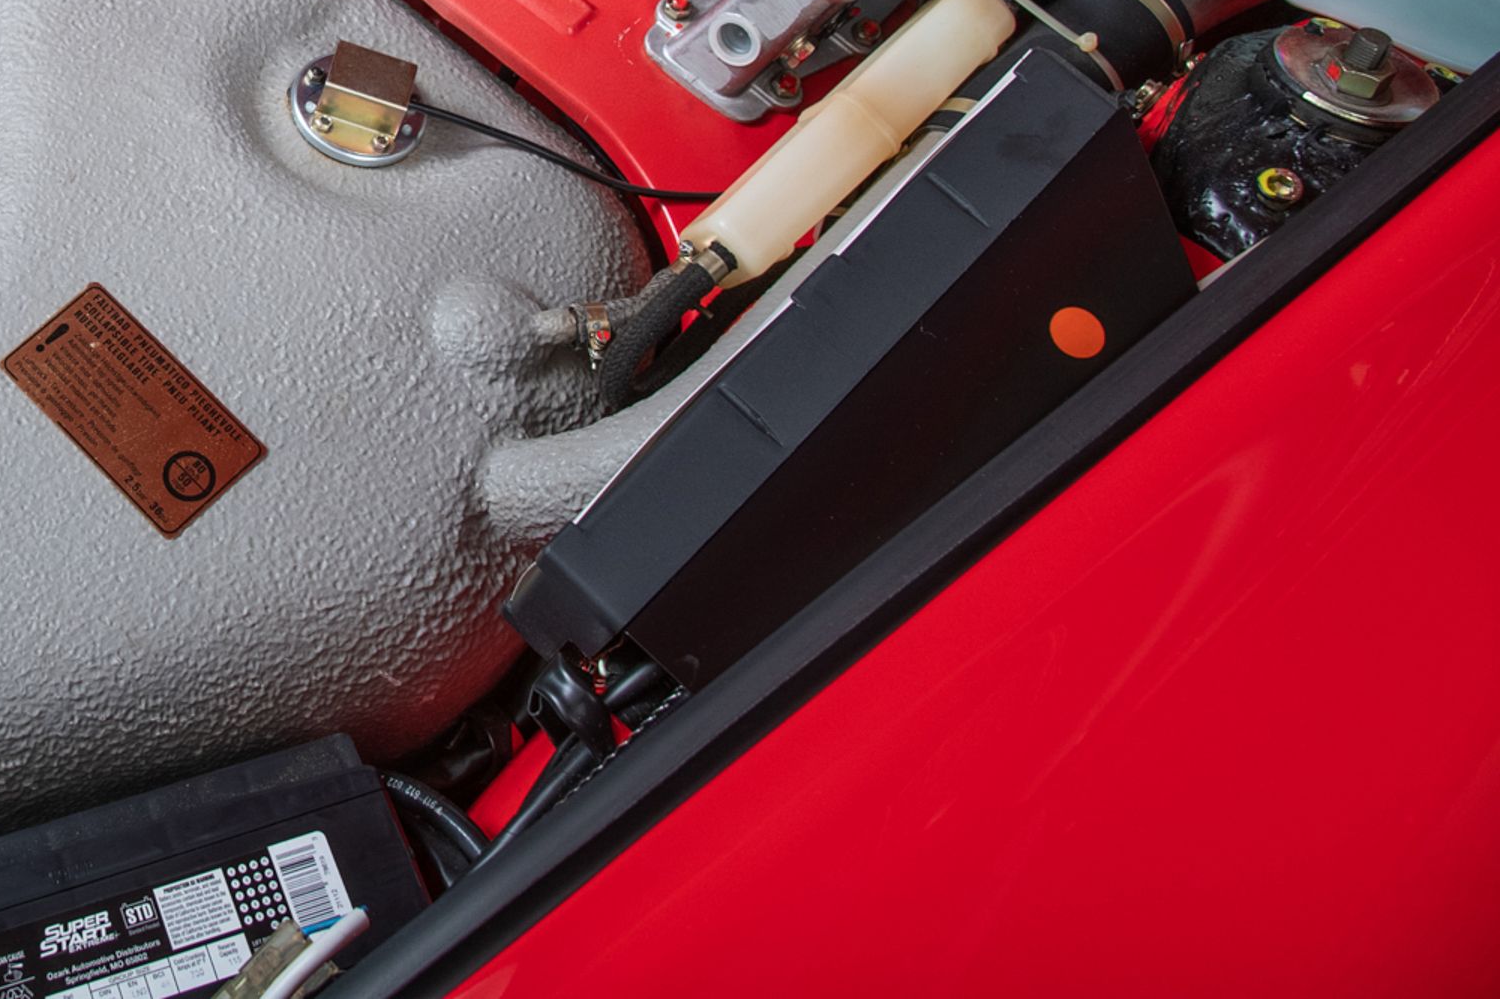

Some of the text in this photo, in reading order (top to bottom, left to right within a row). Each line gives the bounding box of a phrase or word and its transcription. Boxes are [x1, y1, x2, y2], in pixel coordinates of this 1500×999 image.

[82, 301, 138, 355] COLLAPSIBLE
[137, 355, 160, 376] TIRE
[161, 379, 188, 405] PNEU
[186, 404, 221, 437] PLIANT
[133, 333, 191, 390] PNEUMATICO
[188, 389, 243, 442] PIEGHEVOLE
[43, 910, 110, 940] SUPER
[124, 902, 154, 924] STD
[37, 921, 114, 956] START
[45, 938, 161, 980] Ozark Automotive Distributors
[64, 965, 110, 984] Springfield,
[109, 960, 125, 969] MO
